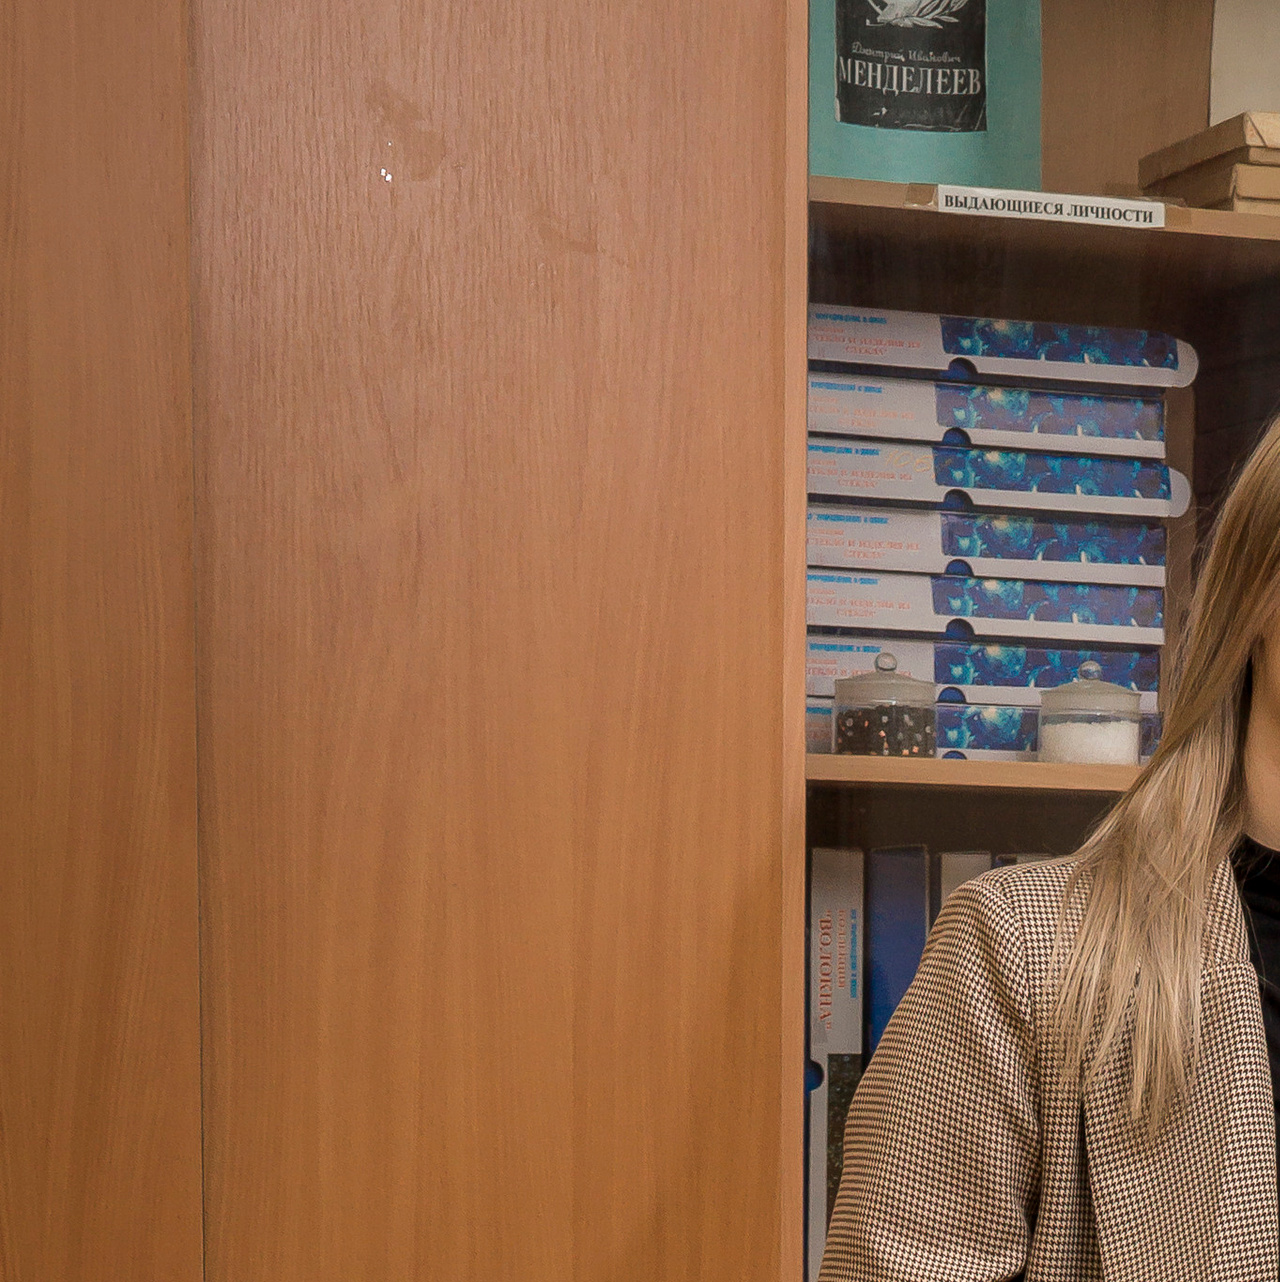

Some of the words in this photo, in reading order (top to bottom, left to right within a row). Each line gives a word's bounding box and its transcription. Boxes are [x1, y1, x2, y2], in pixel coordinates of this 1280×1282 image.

[851, 41, 906, 64] Дмитрий
[908, 49, 962, 64] Иванович
[838, 56, 982, 97] МЕНДЕЛЕЕВ
[944, 193, 1064, 217] ВЫДАЮЩИЕСЯ
[1066, 202, 1154, 225] ЛИЧНОСТИ
